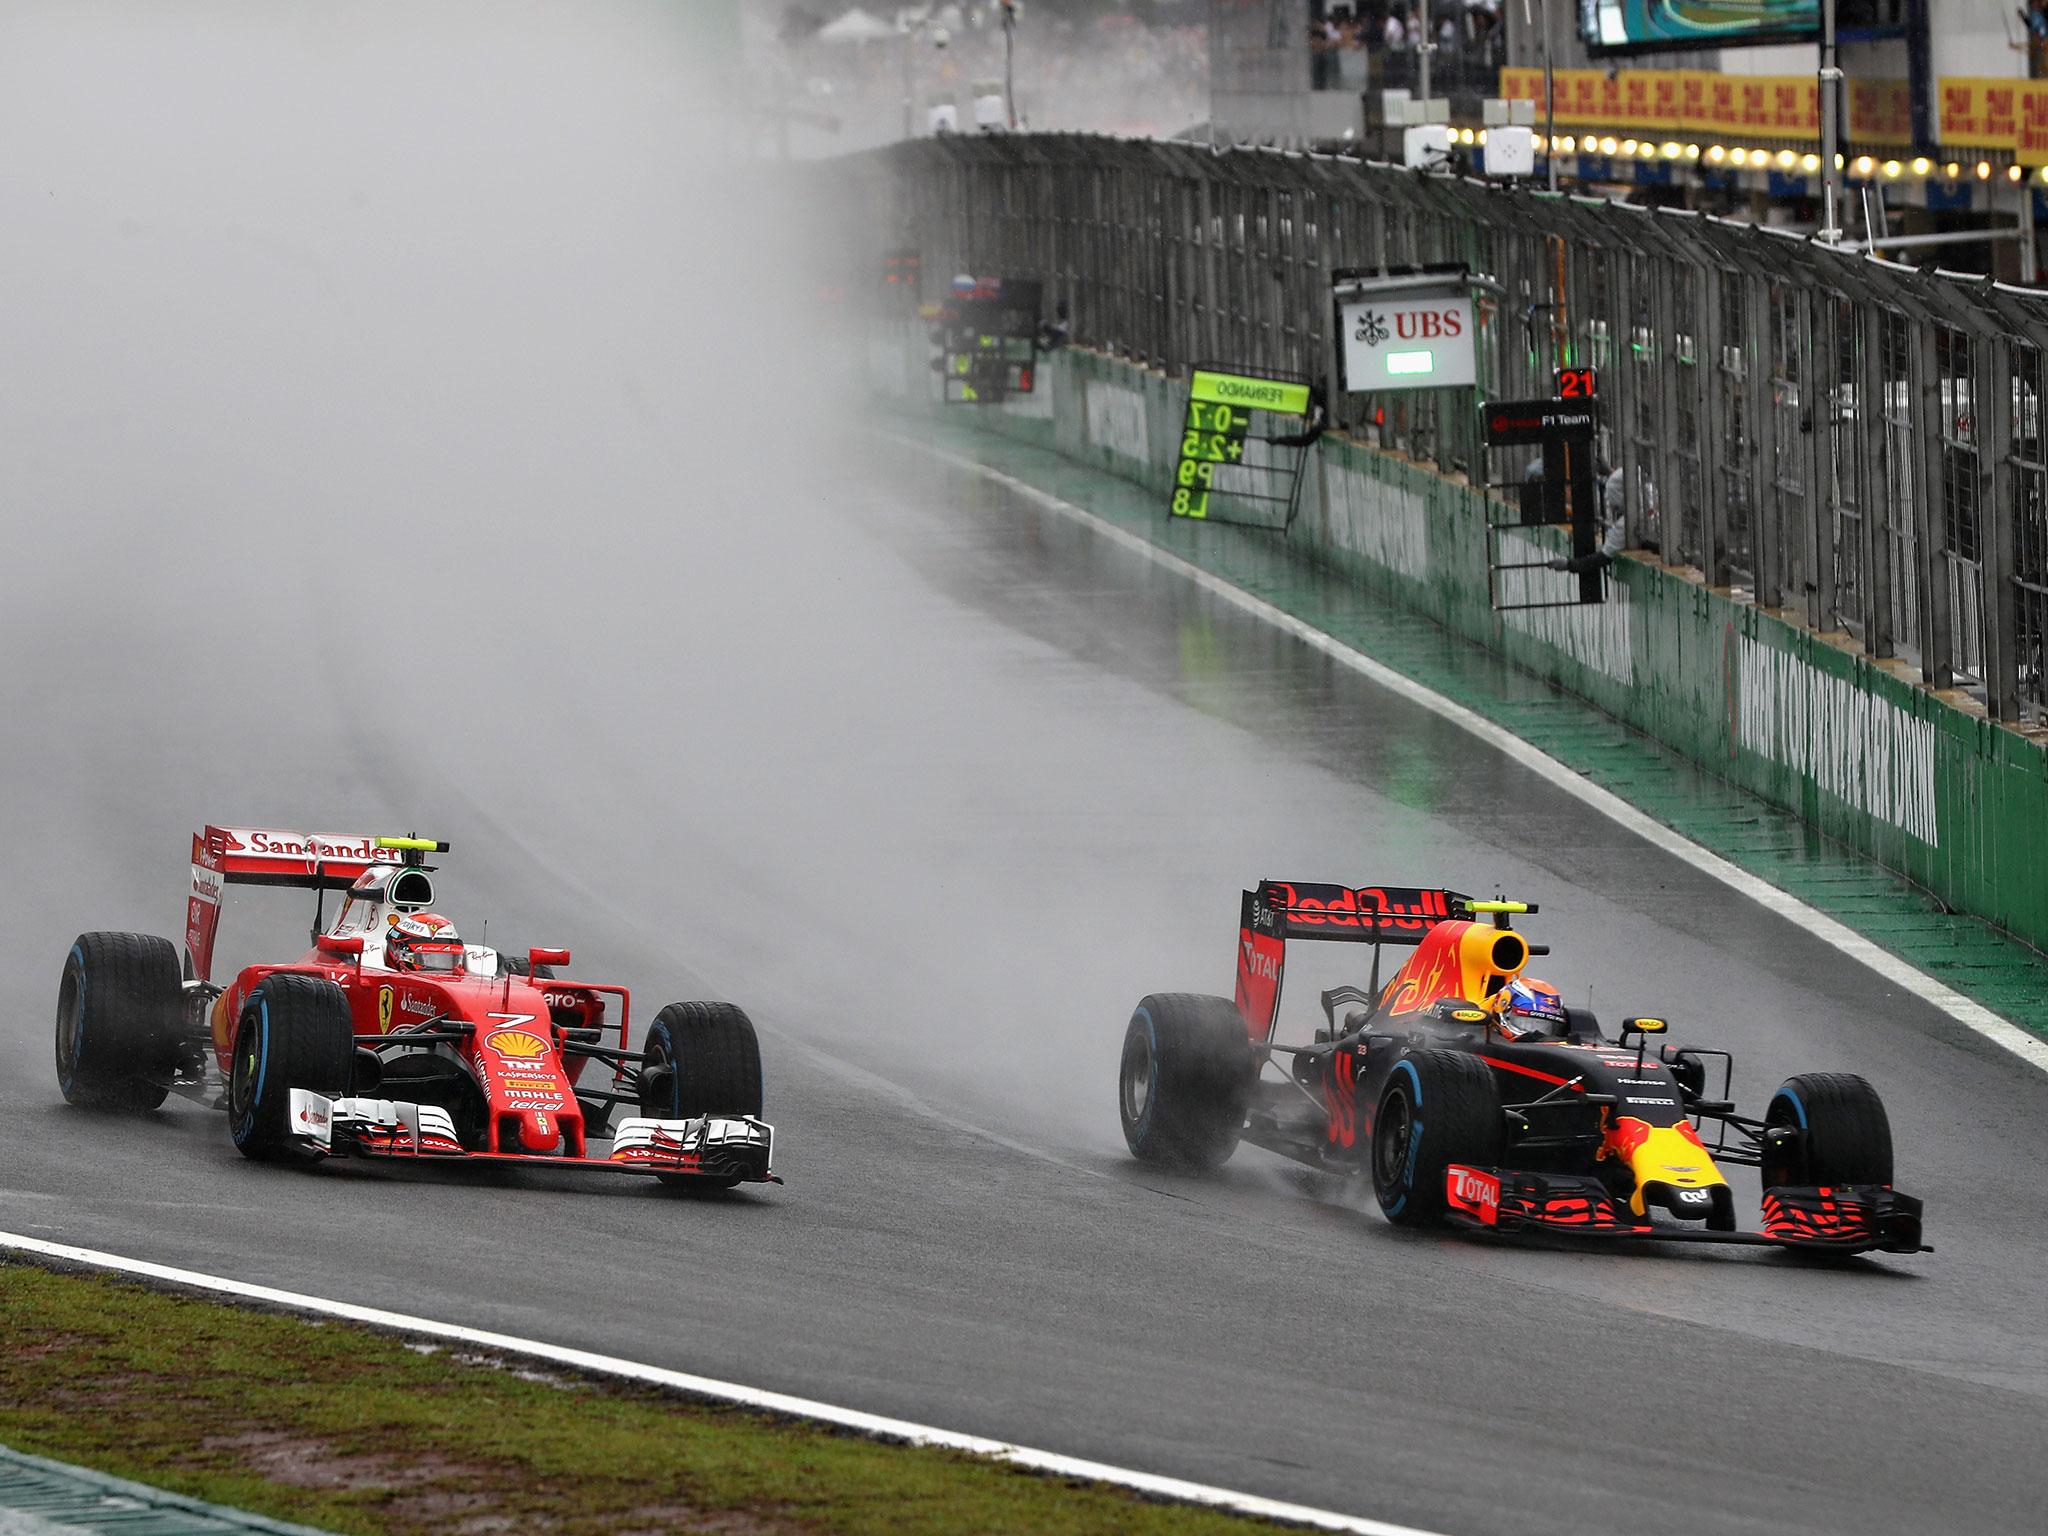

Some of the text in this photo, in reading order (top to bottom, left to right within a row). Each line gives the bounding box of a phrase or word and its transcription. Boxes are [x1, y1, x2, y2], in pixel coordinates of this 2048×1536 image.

[1395, 310, 1462, 339] UBS
[1560, 371, 1594, 398] 21
[1542, 415, 1555, 426] F1
[1557, 414, 1590, 425] Team
[251, 832, 401, 860] Santander
[1259, 909, 1275, 927] AT&T
[1243, 941, 1278, 981] TOTAL
[407, 993, 437, 1017] Santander
[487, 1012, 536, 1028] 7
[500, 1060, 546, 1070] TNT
[1617, 1078, 1667, 1086] Hisense
[504, 1090, 564, 1100] MAHLE
[1626, 1096, 1676, 1106] PIRELLI
[509, 1100, 565, 1111] telcel
[399, 1138, 465, 1151] V-ower
[1448, 1168, 1498, 1208] TOTAL
